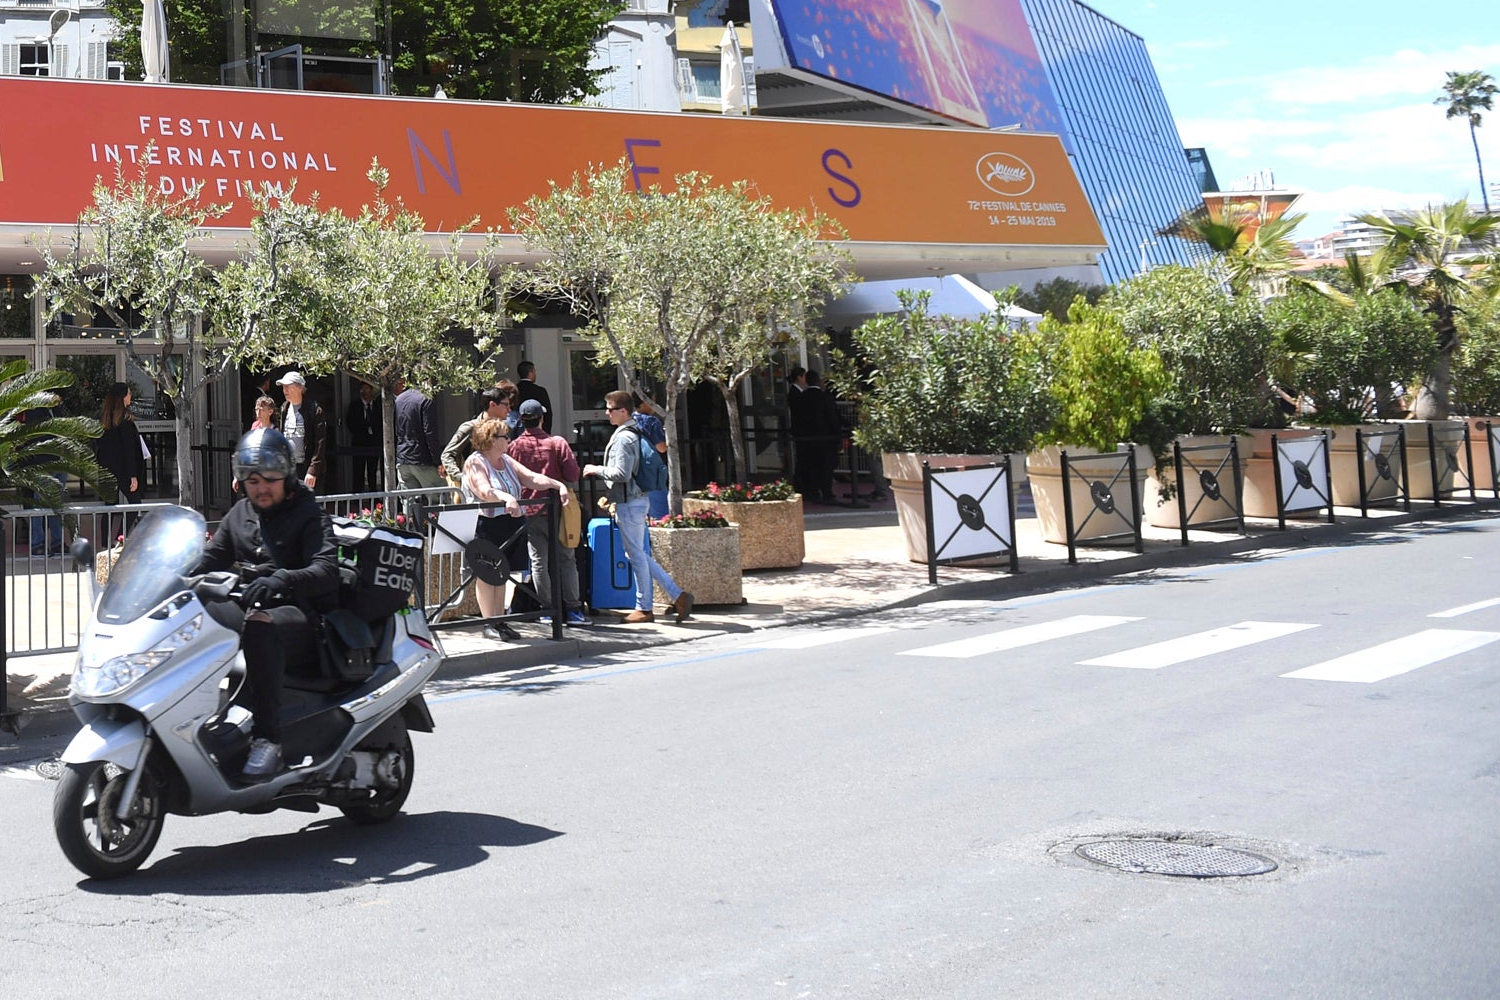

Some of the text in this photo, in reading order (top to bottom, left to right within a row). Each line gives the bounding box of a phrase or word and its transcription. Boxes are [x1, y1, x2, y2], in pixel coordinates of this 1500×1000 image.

[139, 115, 284, 142] FESTIVAL
[91, 143, 337, 172] INTERNATIONAL
[159, 176, 284, 199] DU FILM
[981, 201, 1020, 212] FESTIVAL
[1020, 202, 1032, 212] DE
[1033, 202, 1067, 213] CANNES
[988, 215, 1000, 226] 14
[1007, 215, 1018, 226] 25
[1018, 215, 1035, 226] MAI
[1035, 216, 1056, 227] 2019
[379, 545, 417, 571] Uber
[374, 566, 414, 593] Eats
